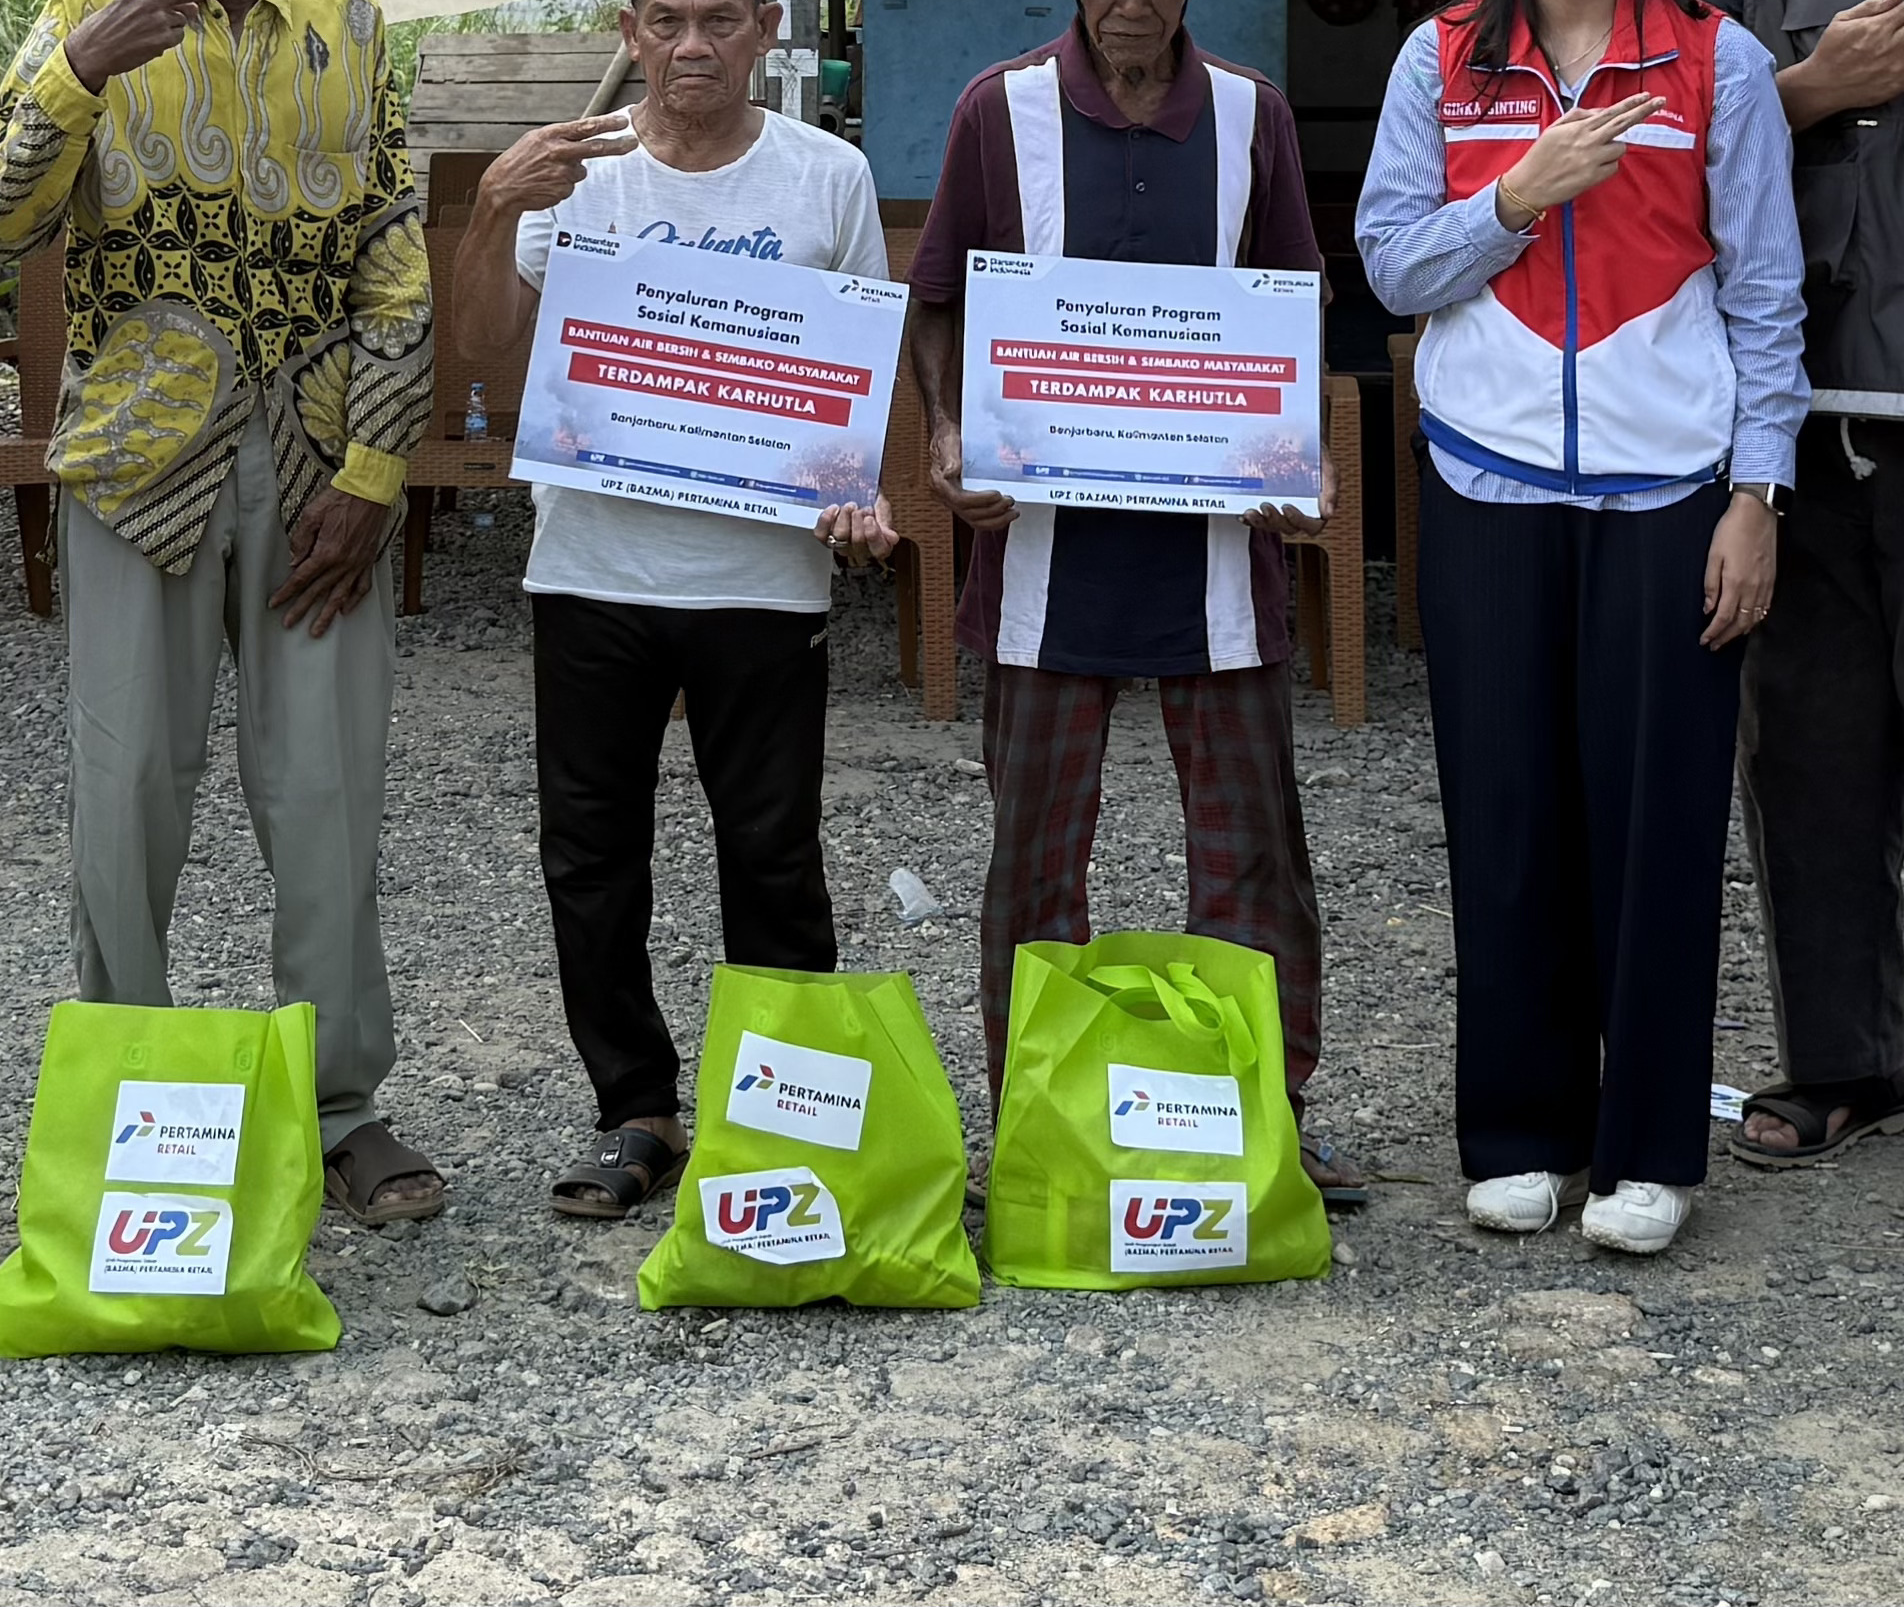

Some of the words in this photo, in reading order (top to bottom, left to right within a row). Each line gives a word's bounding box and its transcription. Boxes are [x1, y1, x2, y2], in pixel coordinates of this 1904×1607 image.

[636, 282, 729, 311] Penyaluran
[733, 298, 805, 325] Program
[1055, 297, 1146, 319] Penyaluran
[1151, 305, 1221, 324] Program
[636, 304, 685, 326] Sosial
[689, 313, 801, 346] Kemanusiaan
[1060, 318, 1107, 336] Sosial
[567, 325, 630, 347] BANTUAN
[631, 336, 654, 351] AIR
[656, 341, 699, 359] BERSIH
[701, 348, 712, 361] &
[714, 350, 775, 371] SEMBAKO
[777, 361, 861, 386] MASYARAKAT
[996, 346, 1057, 361] BANTUAN
[1059, 351, 1080, 362] AIR
[1140, 356, 1201, 371] SEMBAKO
[1203, 359, 1286, 374] MASYARAKAT
[597, 363, 711, 397] TERDAMPAK
[716, 383, 817, 416] KARHUTLA
[1029, 379, 1141, 401] TERDAMPAK
[1148, 386, 1248, 407] KARHUTLA
[776, 1098, 818, 1117] RETAIL
[779, 1082, 862, 1111] PERTAMINA
[1156, 1101, 1239, 1117] PERTAMINA
[159, 1125, 236, 1141] PERTAMINA
[1157, 1116, 1200, 1128] RETAIL
[156, 1143, 197, 1156] RETAIL
[718, 1182, 823, 1235] UPZ
[1124, 1197, 1234, 1240] UPZ
[108, 1210, 221, 1256] UPZ
